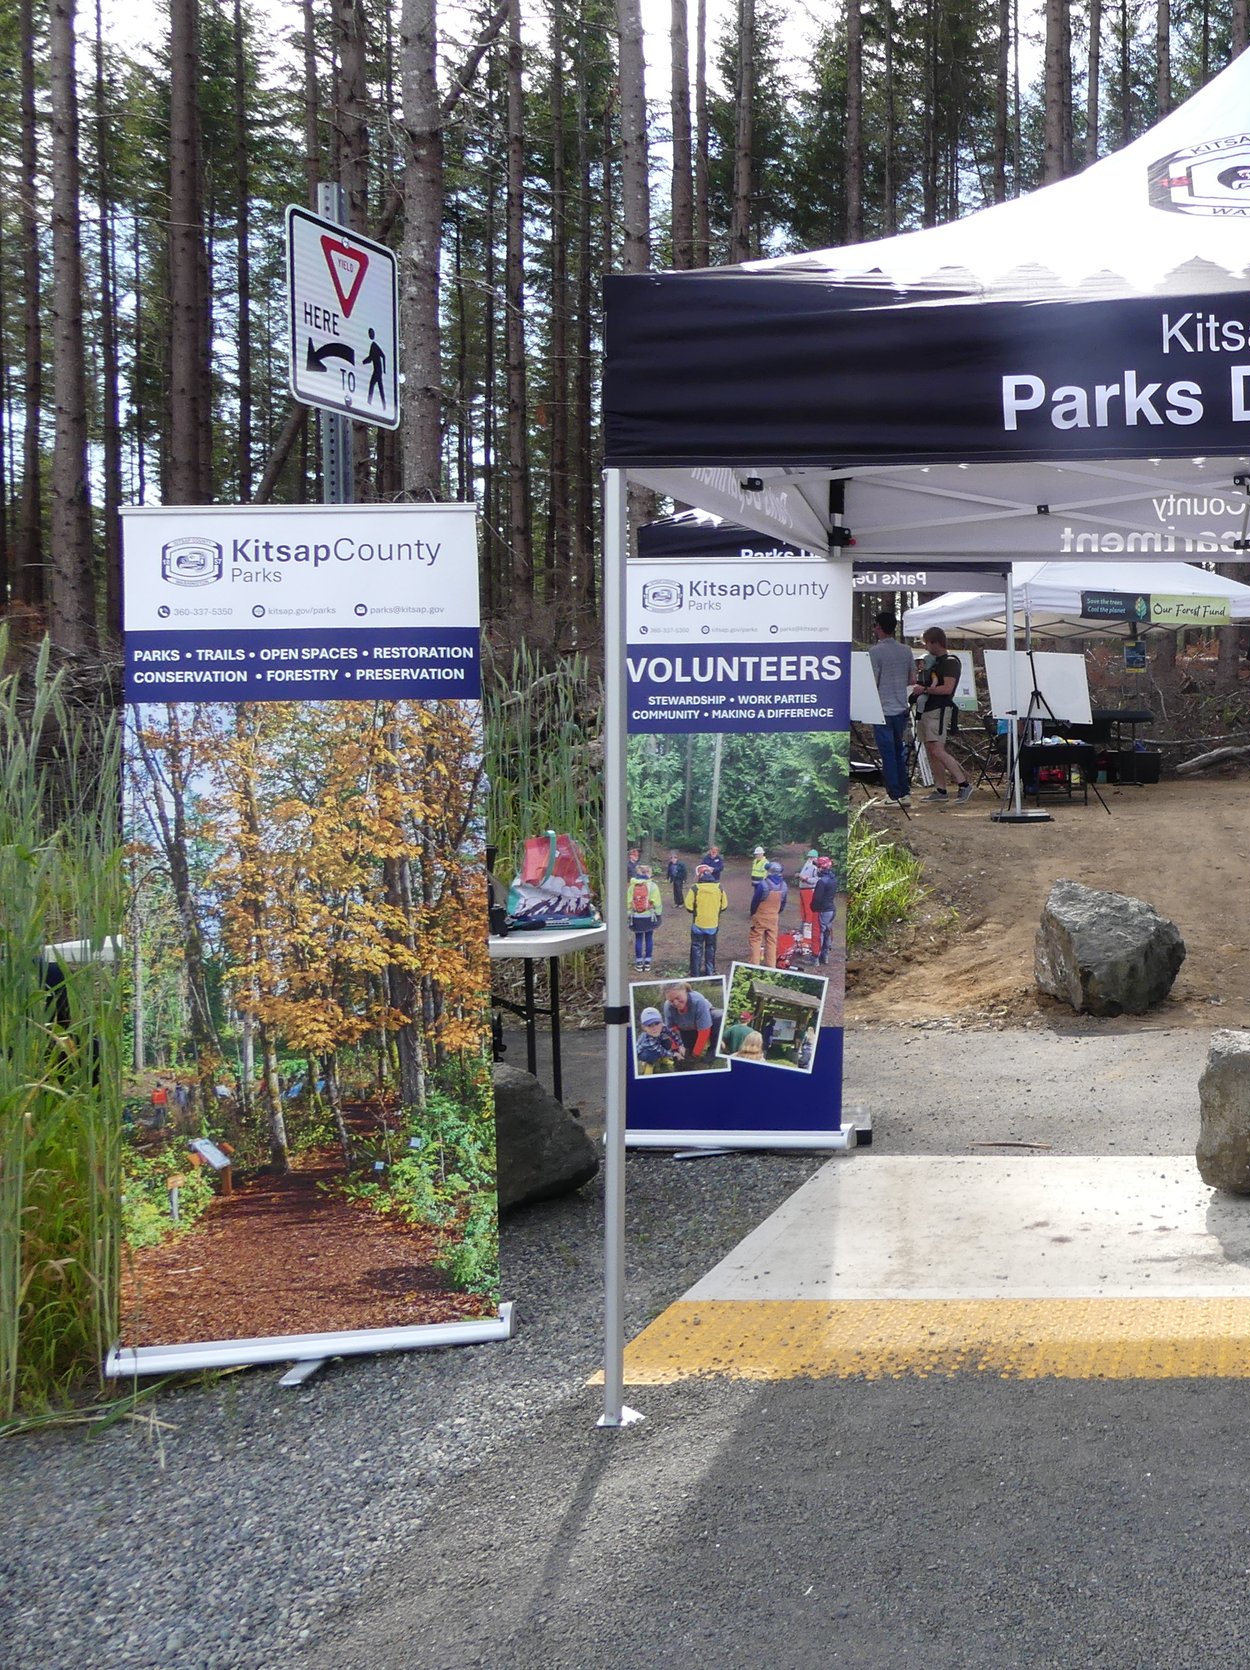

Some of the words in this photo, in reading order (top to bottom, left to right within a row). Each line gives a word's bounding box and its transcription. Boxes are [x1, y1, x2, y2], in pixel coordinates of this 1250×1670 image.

[338, 258, 354, 274] YIELD
[304, 302, 340, 337] HERE
[340, 368, 356, 394] TO
[1002, 370, 1204, 431] Parks
[232, 568, 282, 583] Parks
[173, 607, 233, 617] 360-337-5350
[268, 605, 337, 617] kitsap.gov/parks
[370, 605, 445, 616] parks@kitsap.gov
[688, 600, 722, 611] Parks
[1153, 603, 1173, 616] Our
[1176, 604, 1201, 617] Forest
[1202, 604, 1226, 618] Fund
[133, 649, 180, 662] PARKS
[196, 648, 245, 661] TRAILS
[260, 648, 299, 661] OPEN
[301, 647, 358, 660] SPACES
[373, 646, 474, 659] RESTORATION
[133, 670, 248, 684] CONSERVATION
[266, 668, 338, 682] FORESTRY
[356, 668, 465, 681] PRESERVATION
[627, 655, 842, 683] VOLUNTEERS
[648, 695, 727, 706] STEWARDSHIP
[738, 695, 773, 705] WORK
[774, 694, 818, 705] PARTIES
[632, 710, 700, 720] COMMUNITY
[712, 709, 756, 719] MAKING
[757, 709, 766, 719] A
[767, 708, 834, 719] DIFFERENCE
